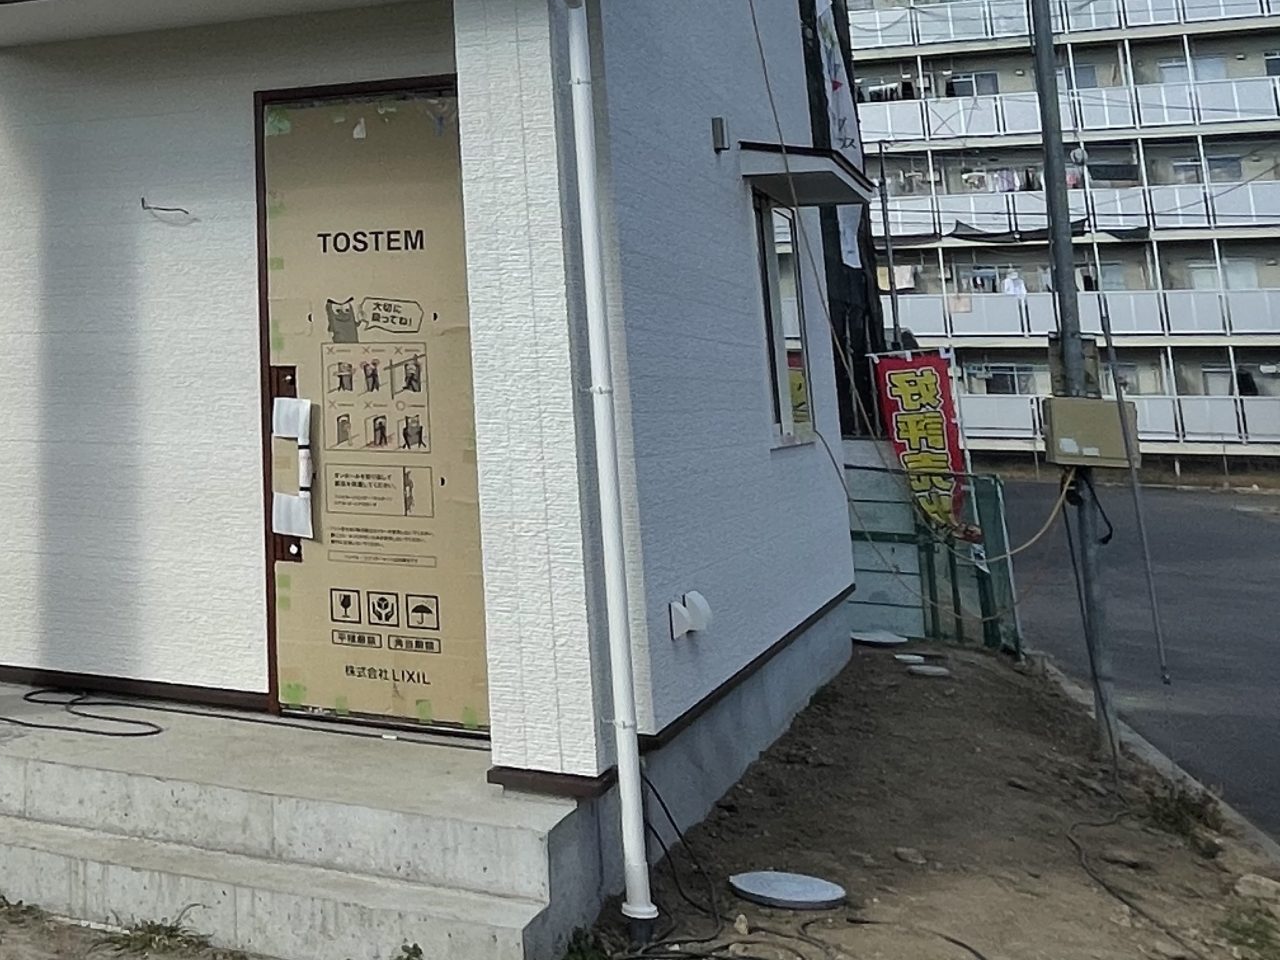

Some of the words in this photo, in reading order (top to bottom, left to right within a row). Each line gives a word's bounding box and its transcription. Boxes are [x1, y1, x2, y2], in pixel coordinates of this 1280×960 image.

[317, 229, 425, 253] TOSTEM
[345, 665, 389, 680] 株式会社
[392, 669, 431, 685] LIXIL
